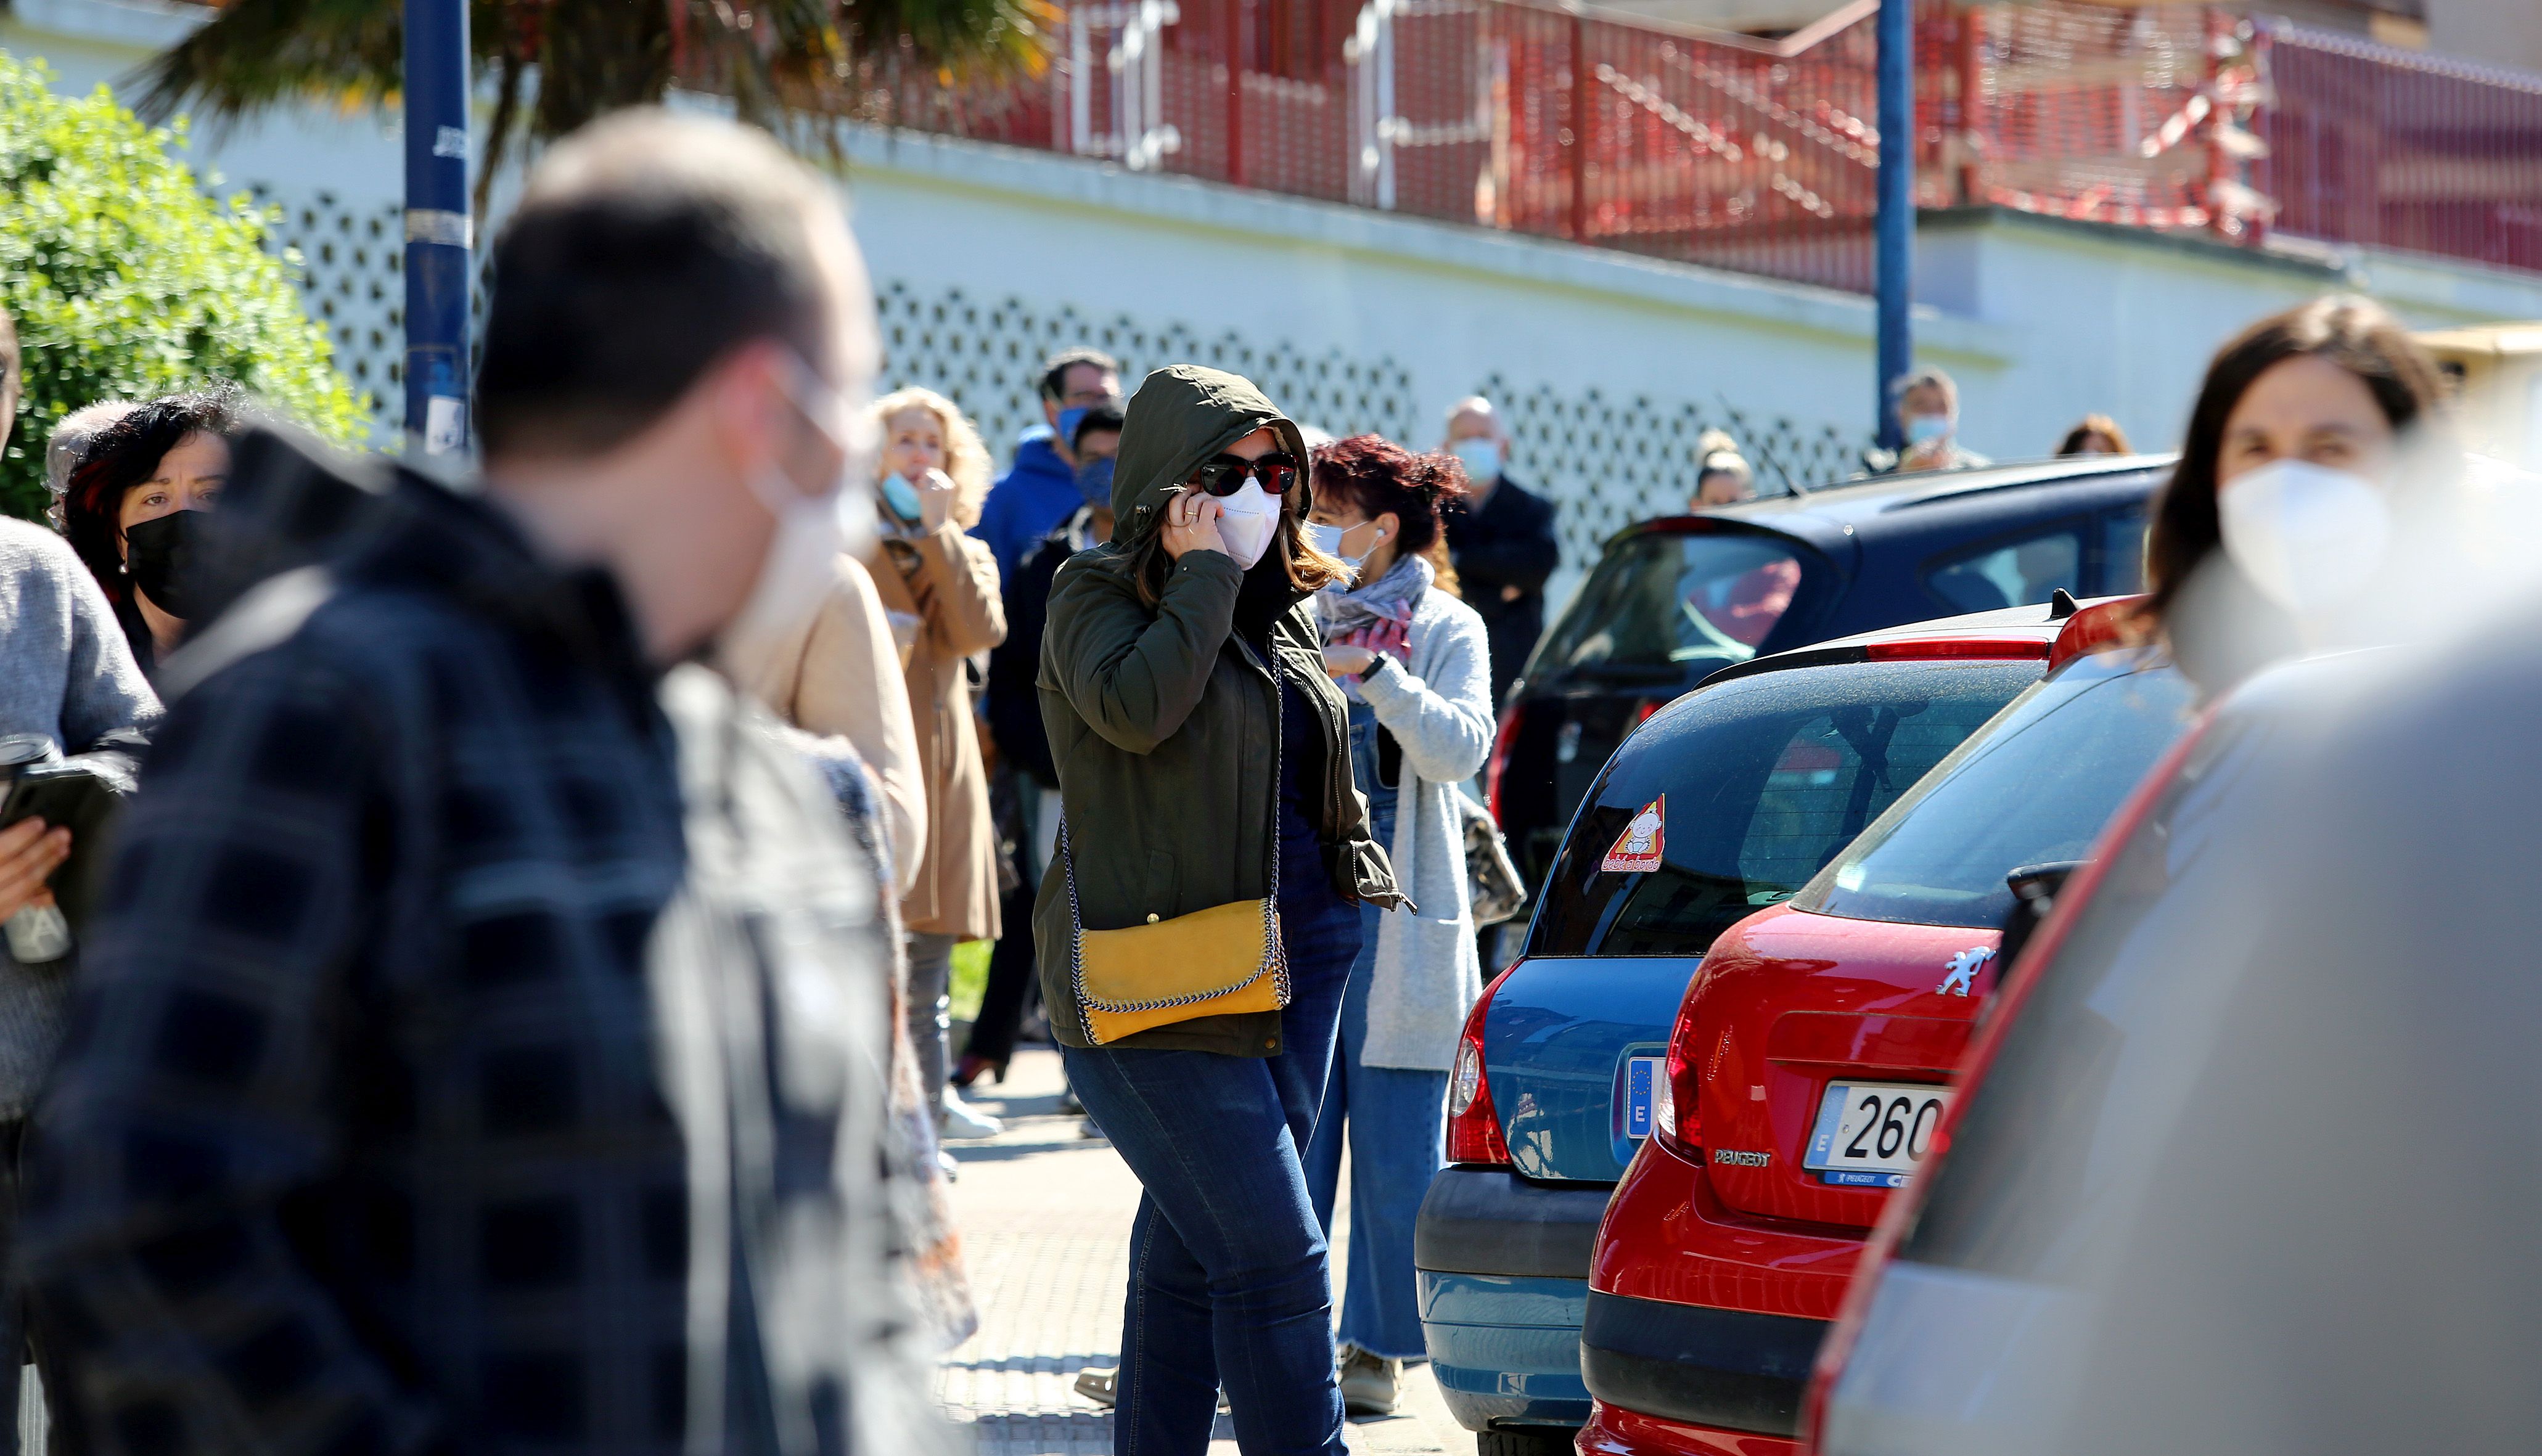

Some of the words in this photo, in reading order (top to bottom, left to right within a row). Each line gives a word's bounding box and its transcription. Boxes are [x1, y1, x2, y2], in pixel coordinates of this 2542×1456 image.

[1603, 854, 1628, 869] bebé
[1626, 860, 1633, 869] a
[1633, 856, 1659, 870] bordo
[1636, 1106, 1646, 1122] E
[1816, 1134, 1830, 1151] E
[1715, 1149, 1771, 1167] PEUGEOT
[1845, 1174, 1876, 1183] PEUGEOT
